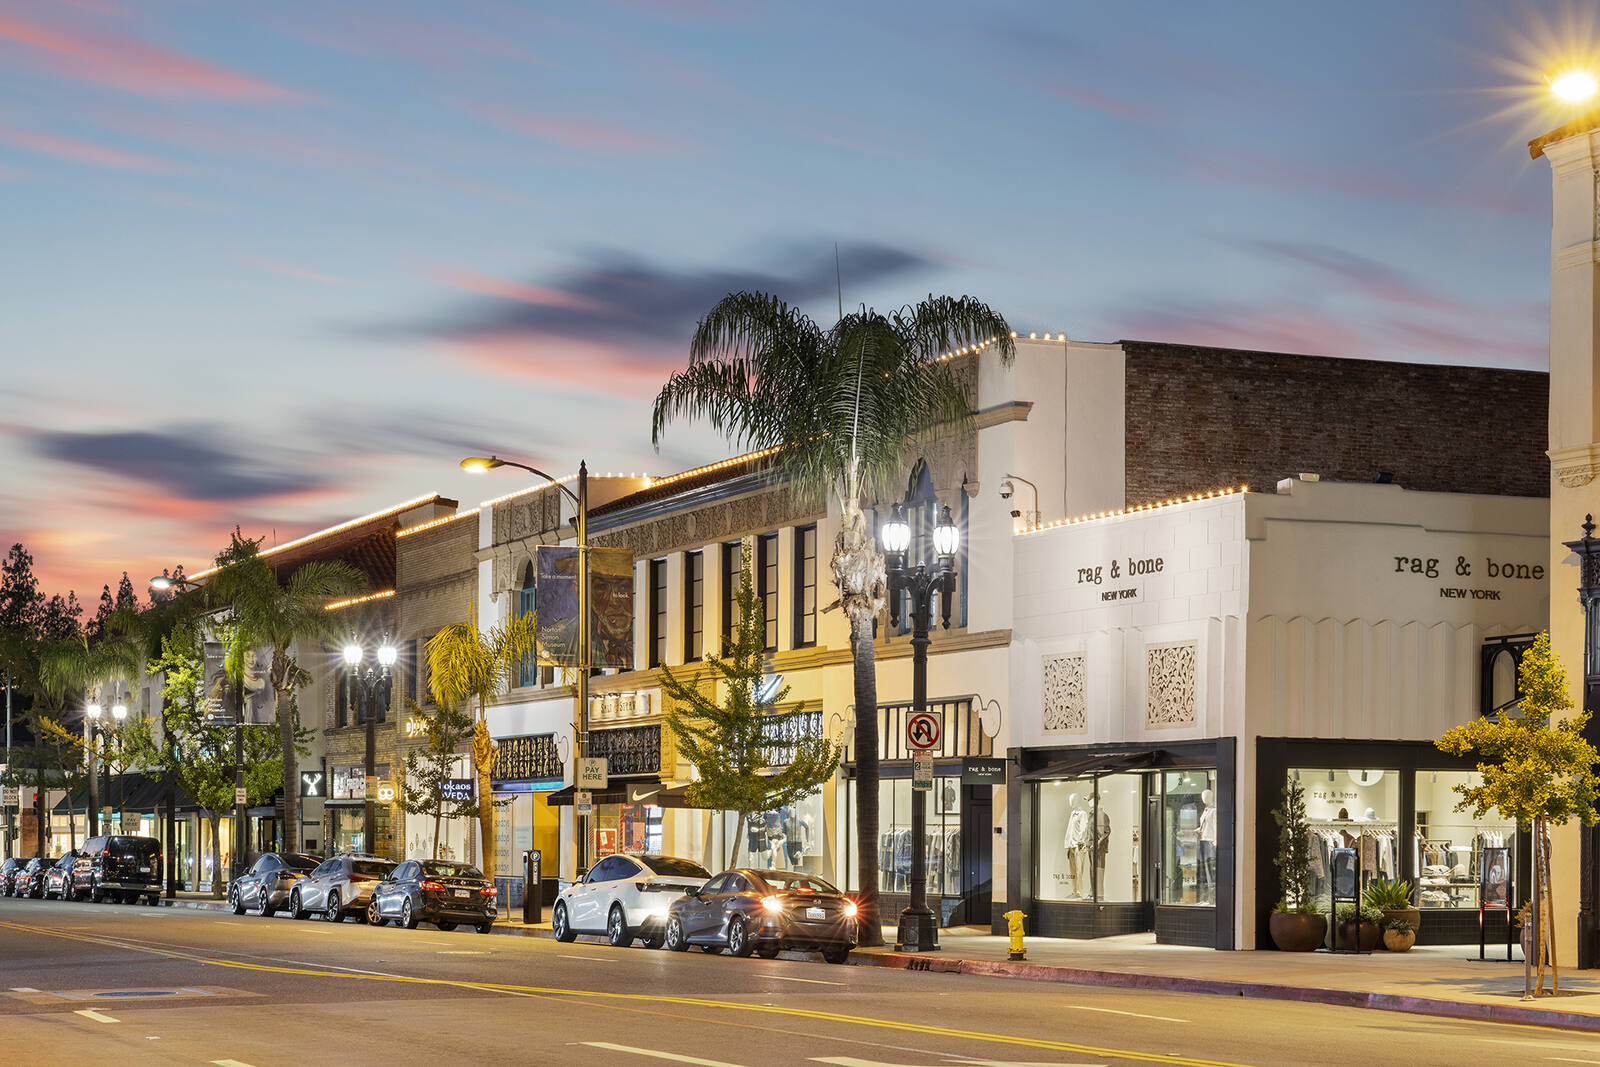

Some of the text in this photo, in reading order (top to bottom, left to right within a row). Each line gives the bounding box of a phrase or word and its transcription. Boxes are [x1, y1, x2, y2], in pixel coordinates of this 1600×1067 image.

[1077, 557, 1164, 585] rag & bone
[1394, 556, 1544, 580] rag & bone
[1101, 588, 1137, 602] NEW YORK
[1440, 587, 1501, 601] NEW YORK
[585, 766, 600, 774] PAY
[915, 762, 921, 770] 2
[1339, 791, 1358, 799] bone
